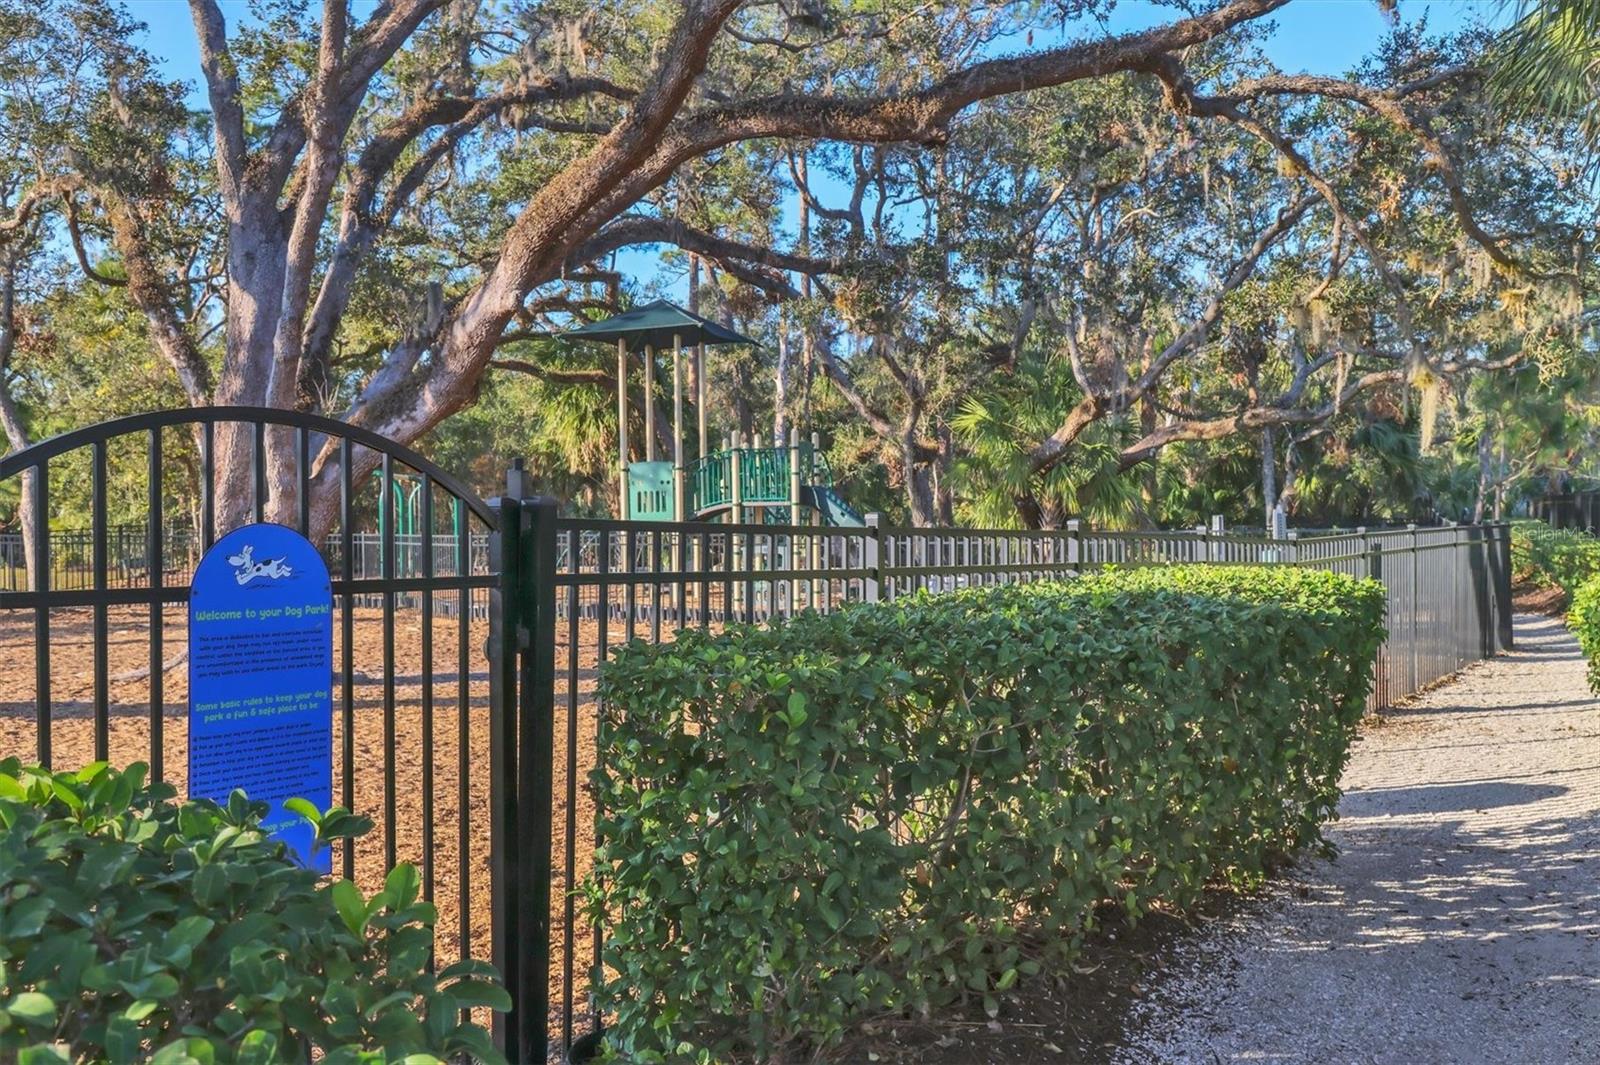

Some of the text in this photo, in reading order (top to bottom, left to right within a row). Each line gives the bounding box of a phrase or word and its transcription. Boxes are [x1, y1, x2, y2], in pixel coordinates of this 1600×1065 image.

[195, 604, 329, 621] Welcome to your Dog Park!
[195, 690, 327, 712] Some basic rules to keep your dog
[204, 712, 223, 724] park
[234, 710, 248, 720] fun
[250, 707, 257, 717] &
[258, 705, 276, 717] safe
[277, 703, 297, 714] place
[299, 702, 307, 710] to
